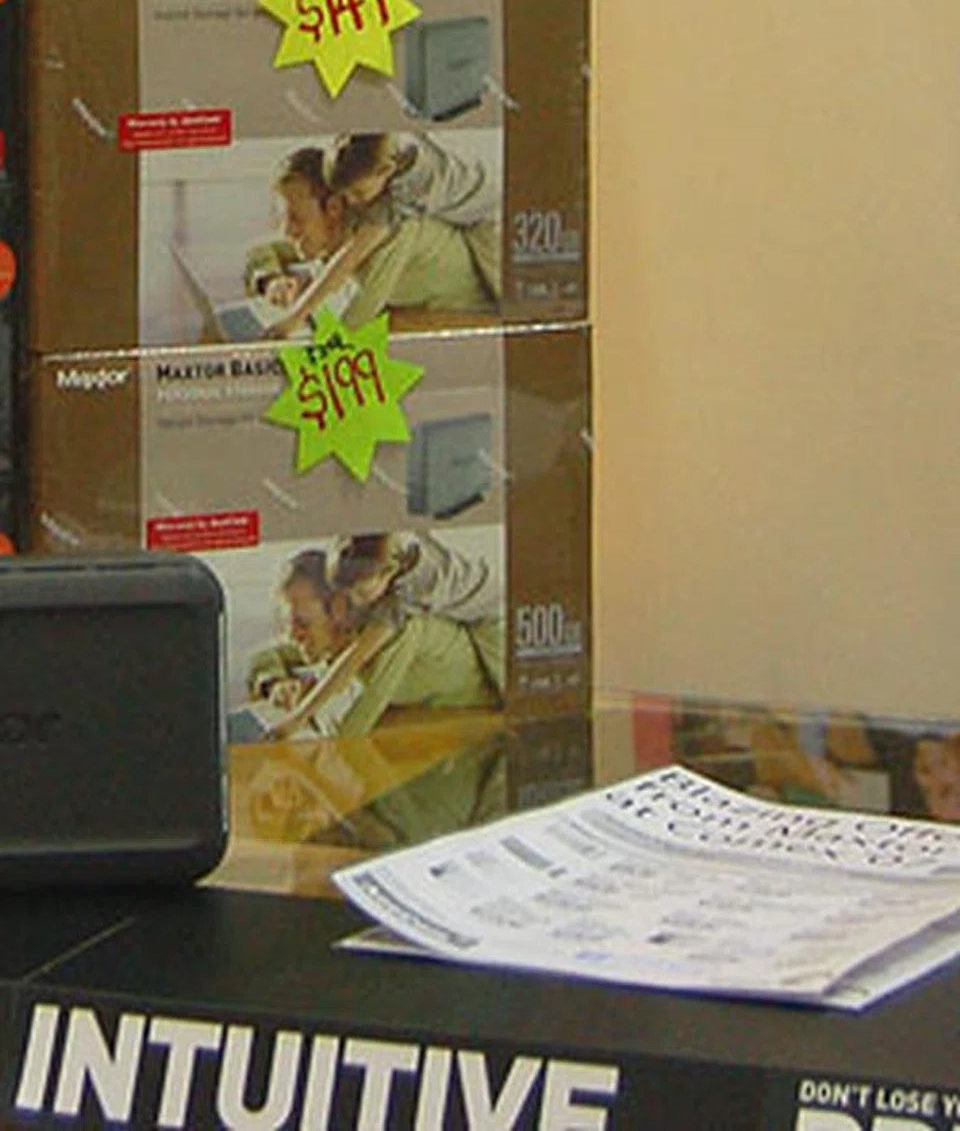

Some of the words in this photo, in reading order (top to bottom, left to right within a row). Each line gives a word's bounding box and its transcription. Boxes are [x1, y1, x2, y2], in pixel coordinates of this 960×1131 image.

[56, 369, 130, 393] Maxtor
[298, 349, 386, 430] $199
[15, 1003, 621, 1131] INTUITIVE
[799, 1079, 872, 1109] DON'T
[876, 1087, 938, 1117] LOSE
